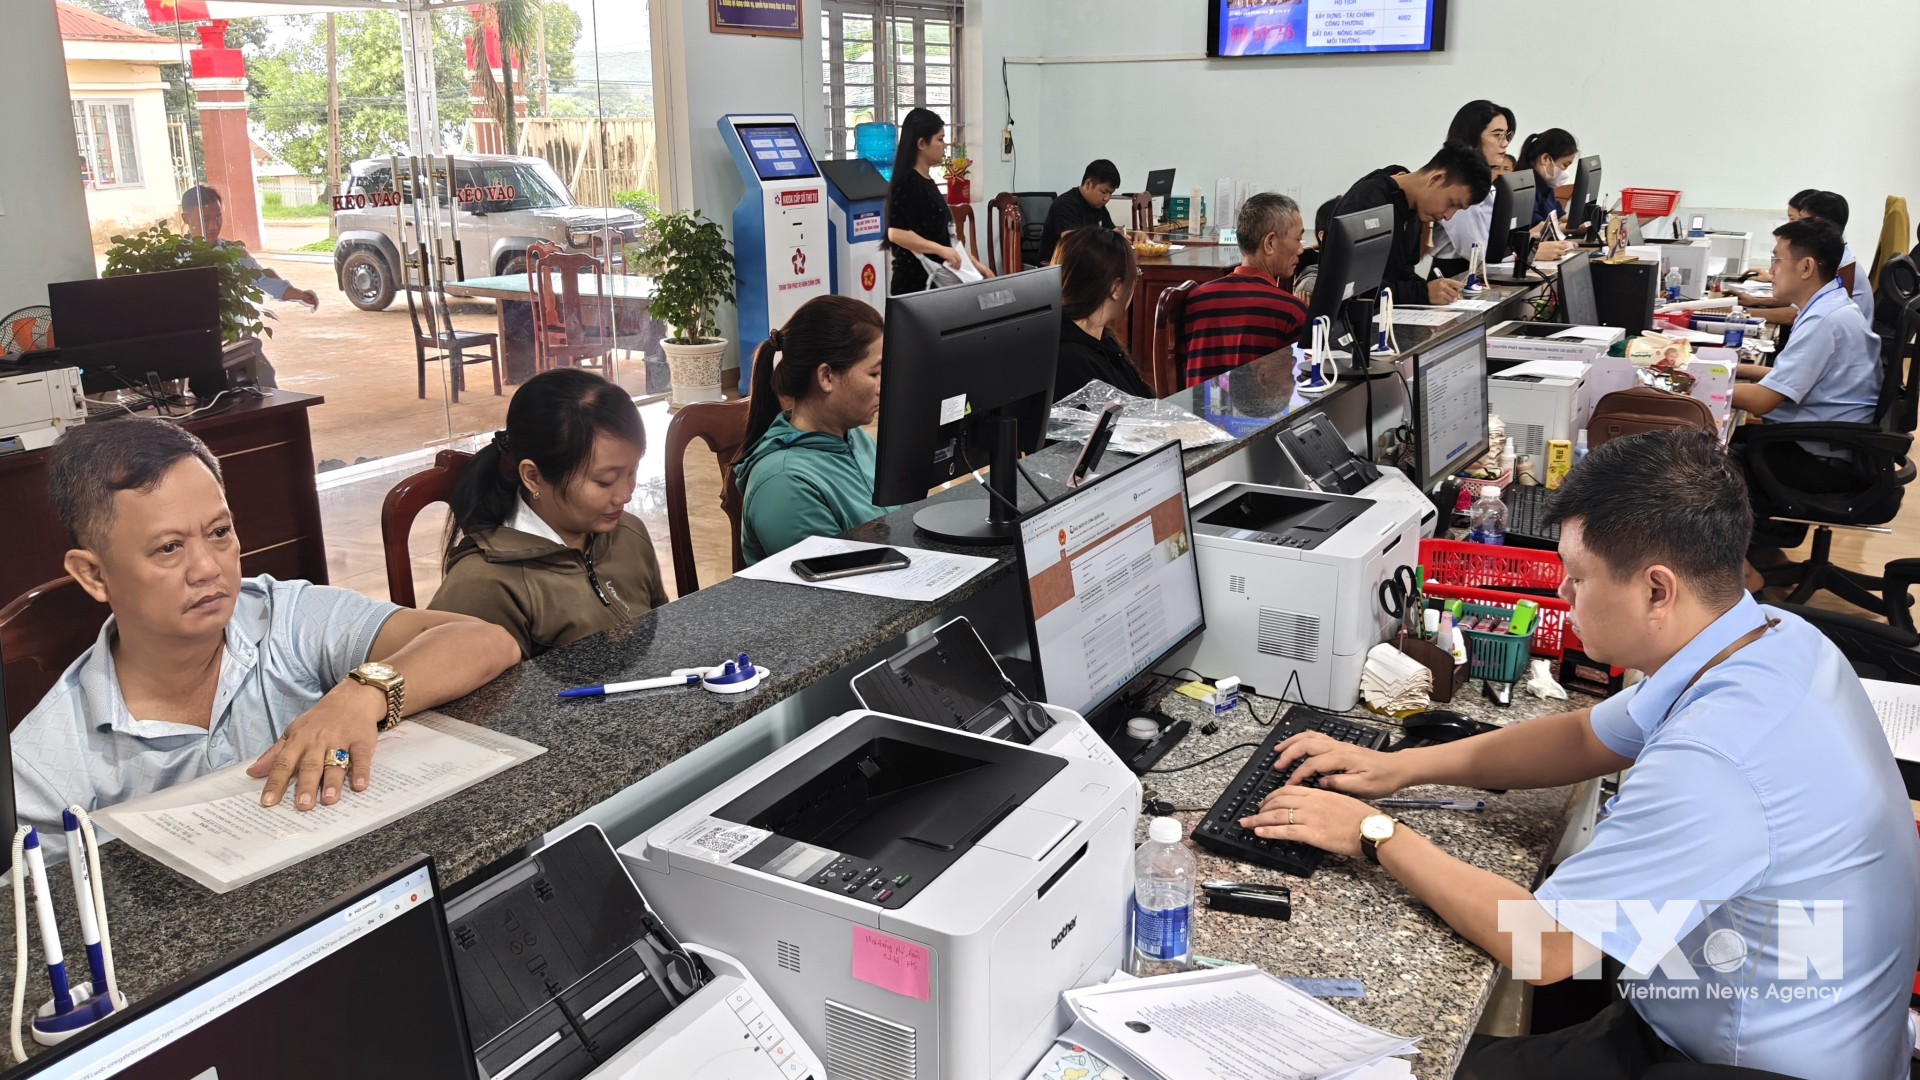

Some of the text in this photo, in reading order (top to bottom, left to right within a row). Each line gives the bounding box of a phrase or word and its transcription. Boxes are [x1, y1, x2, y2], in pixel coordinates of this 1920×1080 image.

[333, 187, 402, 211] KÉO VÀO
[456, 179, 516, 203] KÉO VÀO
[362, 899, 377, 909] Gemini
[1051, 914, 1077, 950] brother
